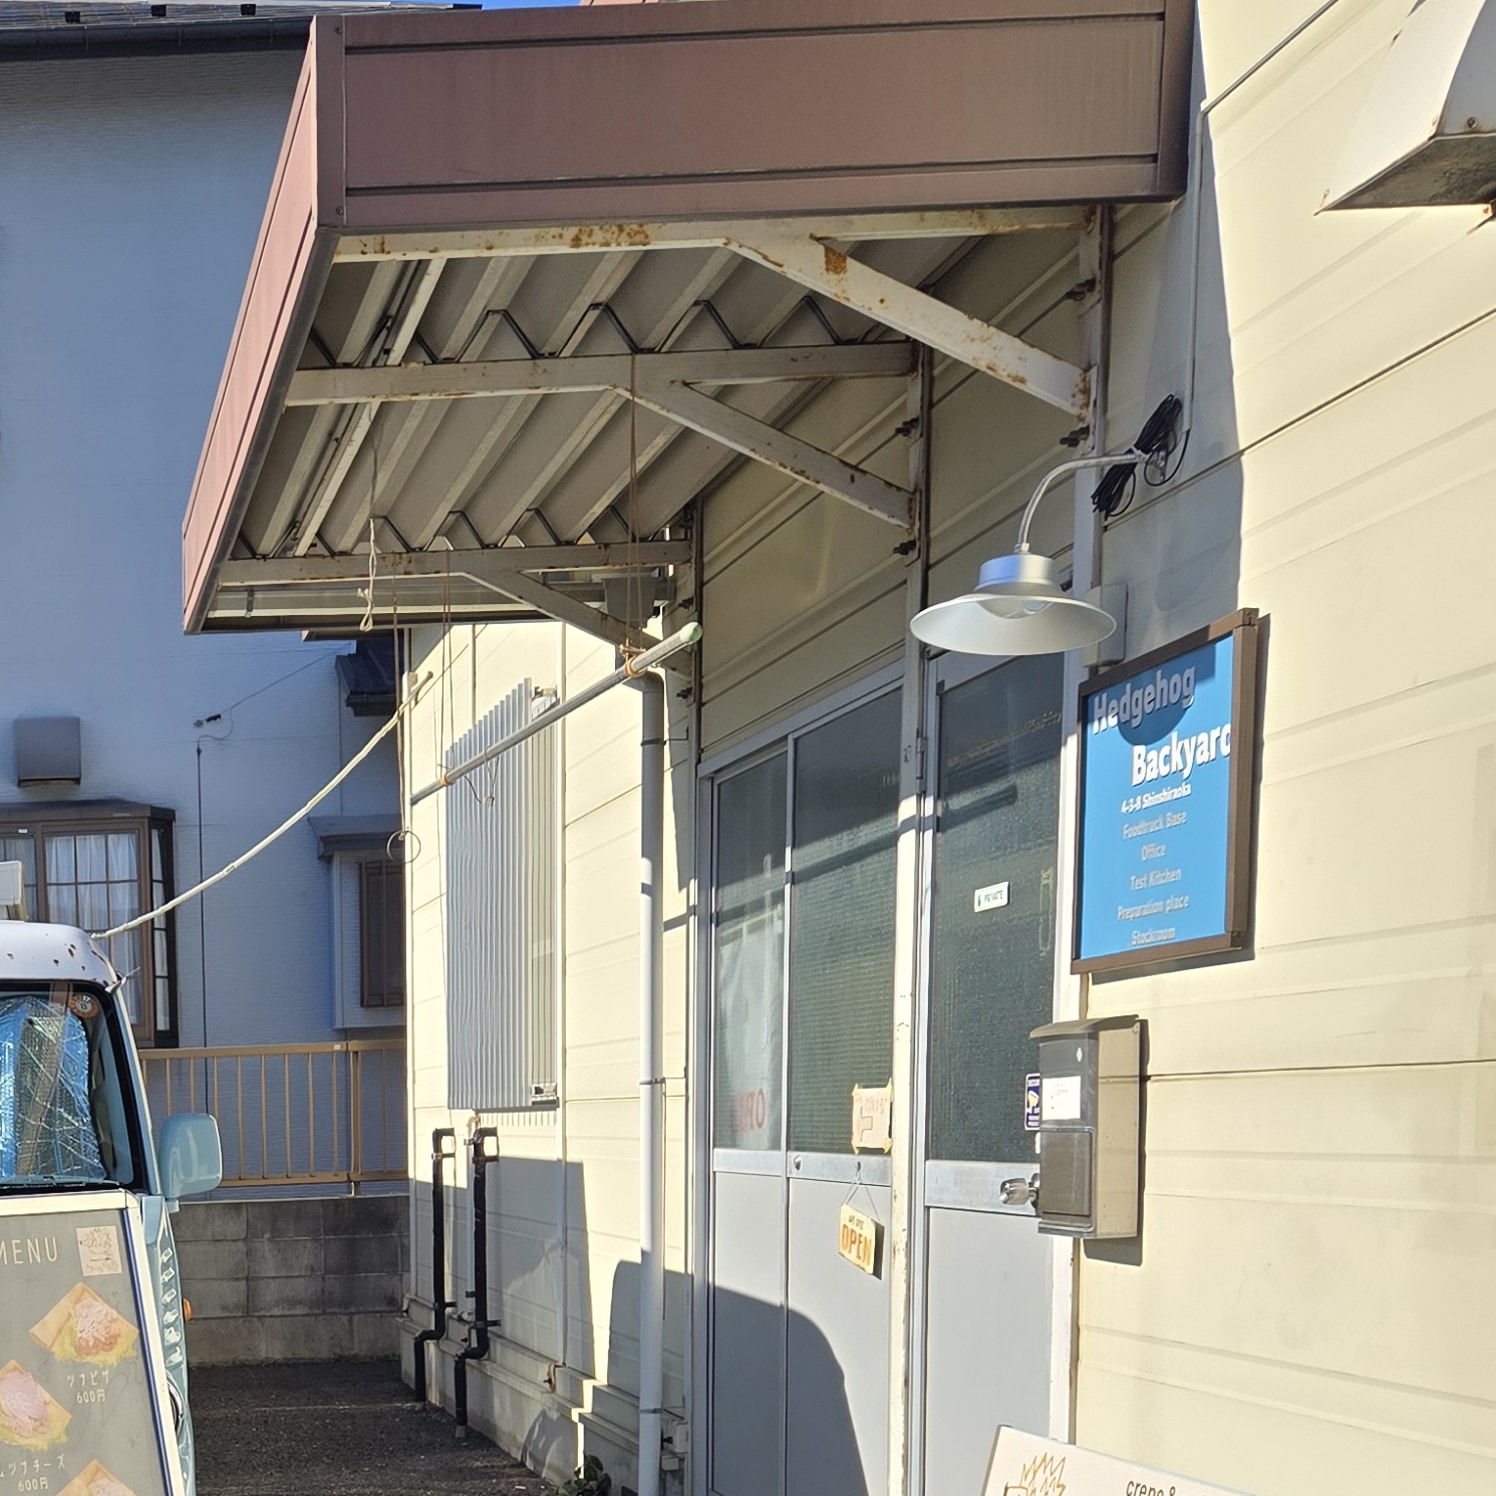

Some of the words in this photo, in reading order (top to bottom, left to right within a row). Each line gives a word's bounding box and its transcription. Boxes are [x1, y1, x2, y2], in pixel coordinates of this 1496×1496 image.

[1092, 663, 1196, 735] Hedgehog
[1166, 811, 1187, 828] Base
[1142, 843, 1166, 861] Office
[1130, 874, 1148, 891] Test
[1148, 868, 1182, 887] Kitchen
[1117, 899, 1164, 922] Preparation
[1164, 894, 1189, 914] place
[841, 1223, 872, 1266] OPEN
[67, 1369, 111, 1389] ツナピザ
[76, 1389, 106, 1404] 600円
[18, 1476, 49, 1492] 600円
